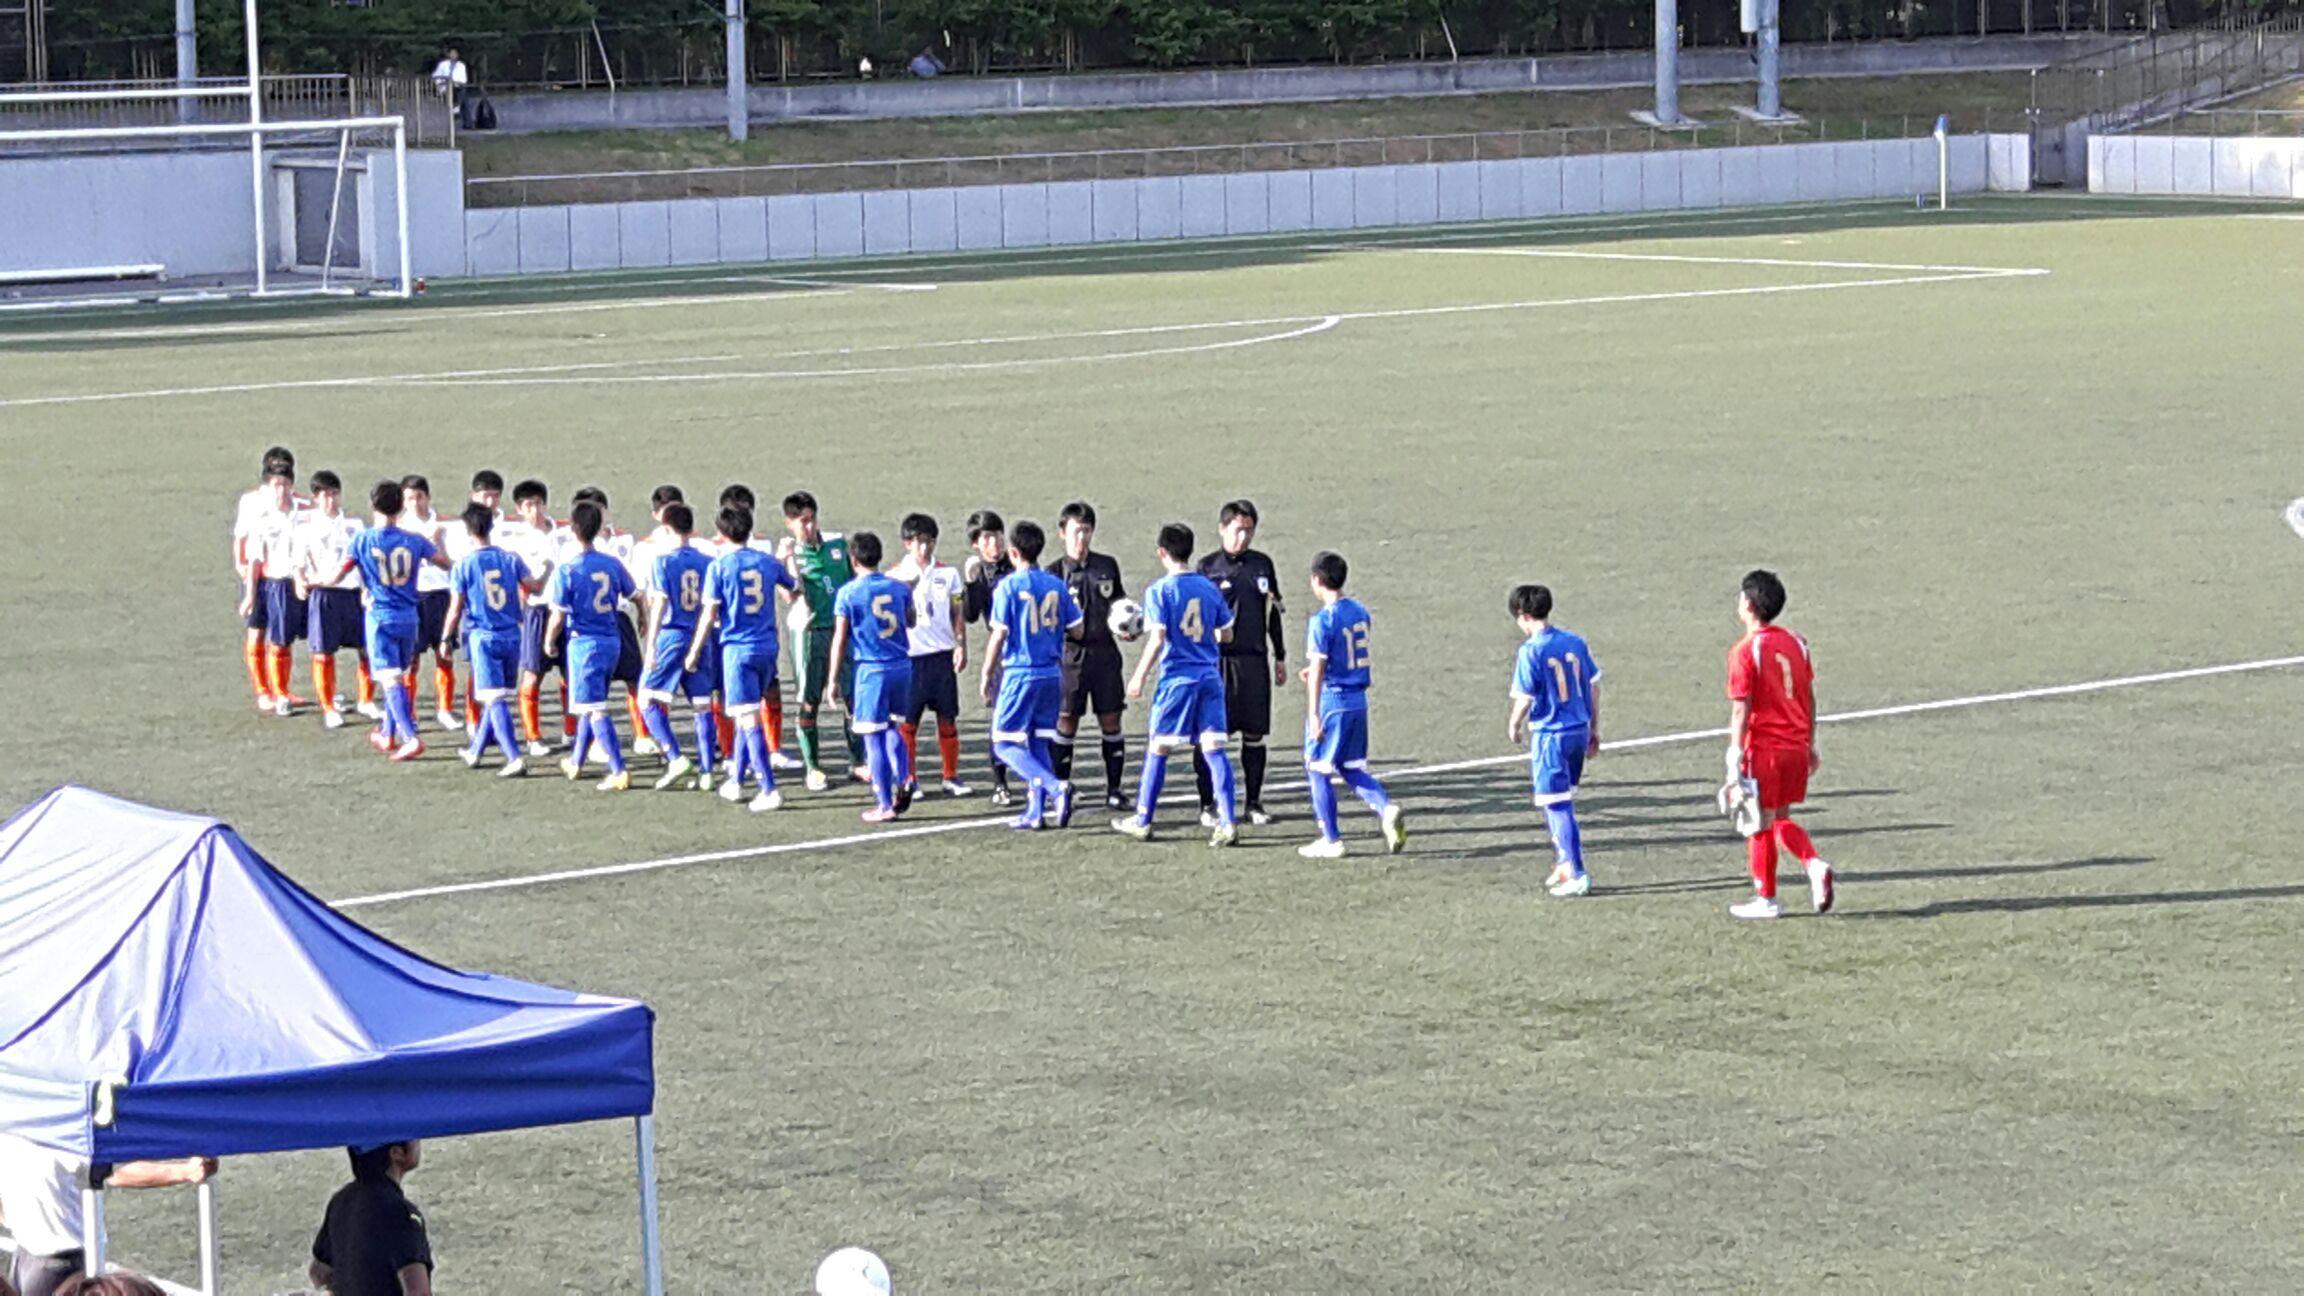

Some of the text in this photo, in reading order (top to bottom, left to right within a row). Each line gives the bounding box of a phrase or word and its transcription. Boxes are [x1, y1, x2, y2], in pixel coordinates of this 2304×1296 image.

[371, 546, 412, 586] 10
[484, 568, 506, 611] 6
[591, 571, 612, 614] 2
[680, 568, 700, 611] 8
[740, 568, 764, 614] 3
[871, 594, 897, 639] 5
[1018, 590, 1060, 635] 14
[1179, 597, 1204, 643] 4
[1548, 651, 1583, 703] 11
[1775, 651, 1795, 700] 1
